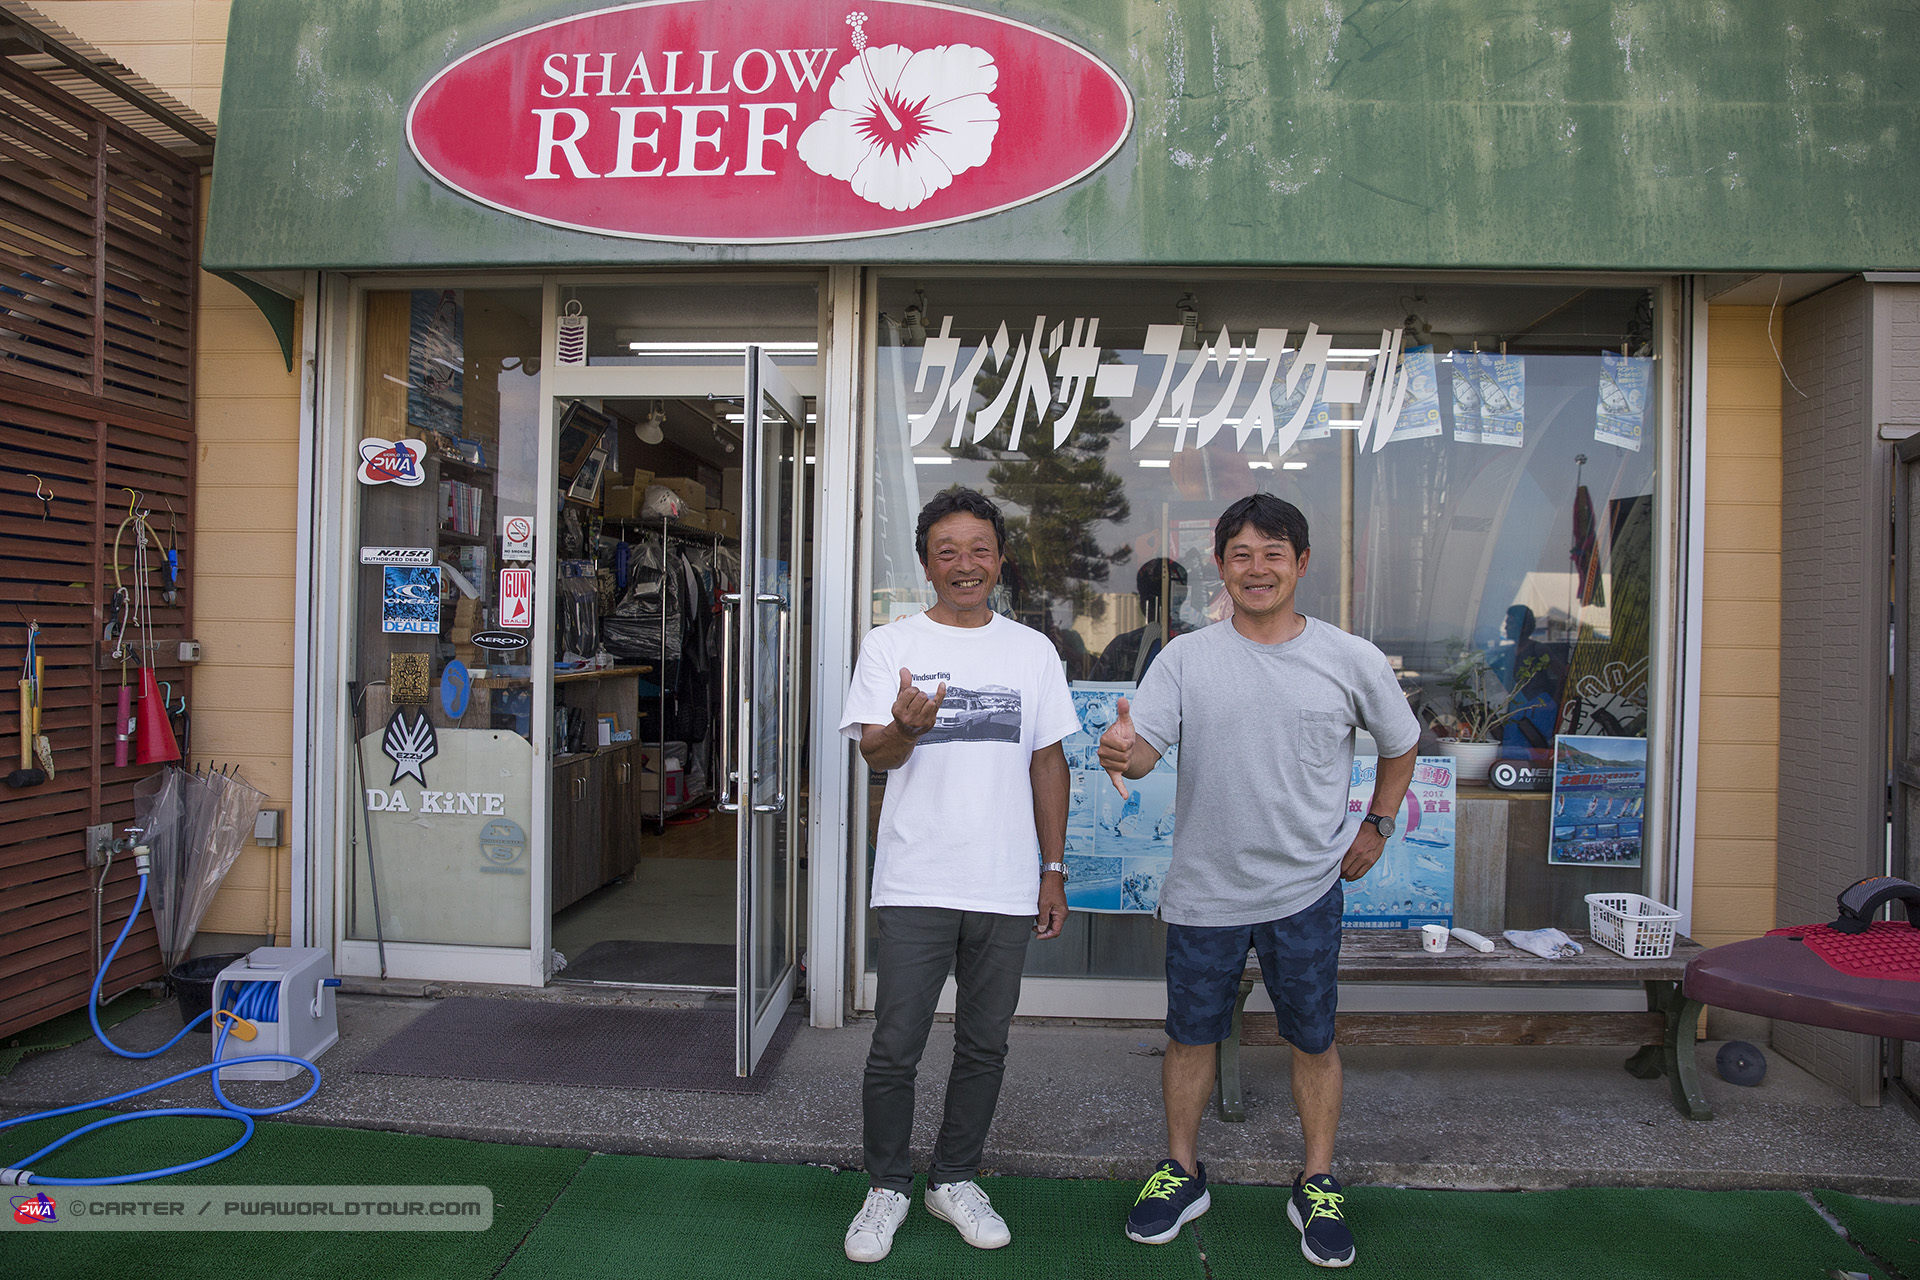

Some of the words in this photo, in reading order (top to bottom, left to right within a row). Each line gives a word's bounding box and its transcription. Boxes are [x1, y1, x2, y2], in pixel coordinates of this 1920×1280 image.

[540, 48, 838, 98] SHALLOW
[524, 102, 797, 180] REEF
[910, 315, 1409, 457] ウィンドサーフィンスクール
[372, 457, 411, 472] PWA
[505, 572, 528, 598] GUN
[384, 621, 439, 633] DEALER
[474, 636, 525, 645] AERON
[396, 752, 424, 760] EZZY
[366, 788, 411, 812] DA
[1423, 790, 1444, 798] 2017
[1423, 799, 1451, 813] 宣言
